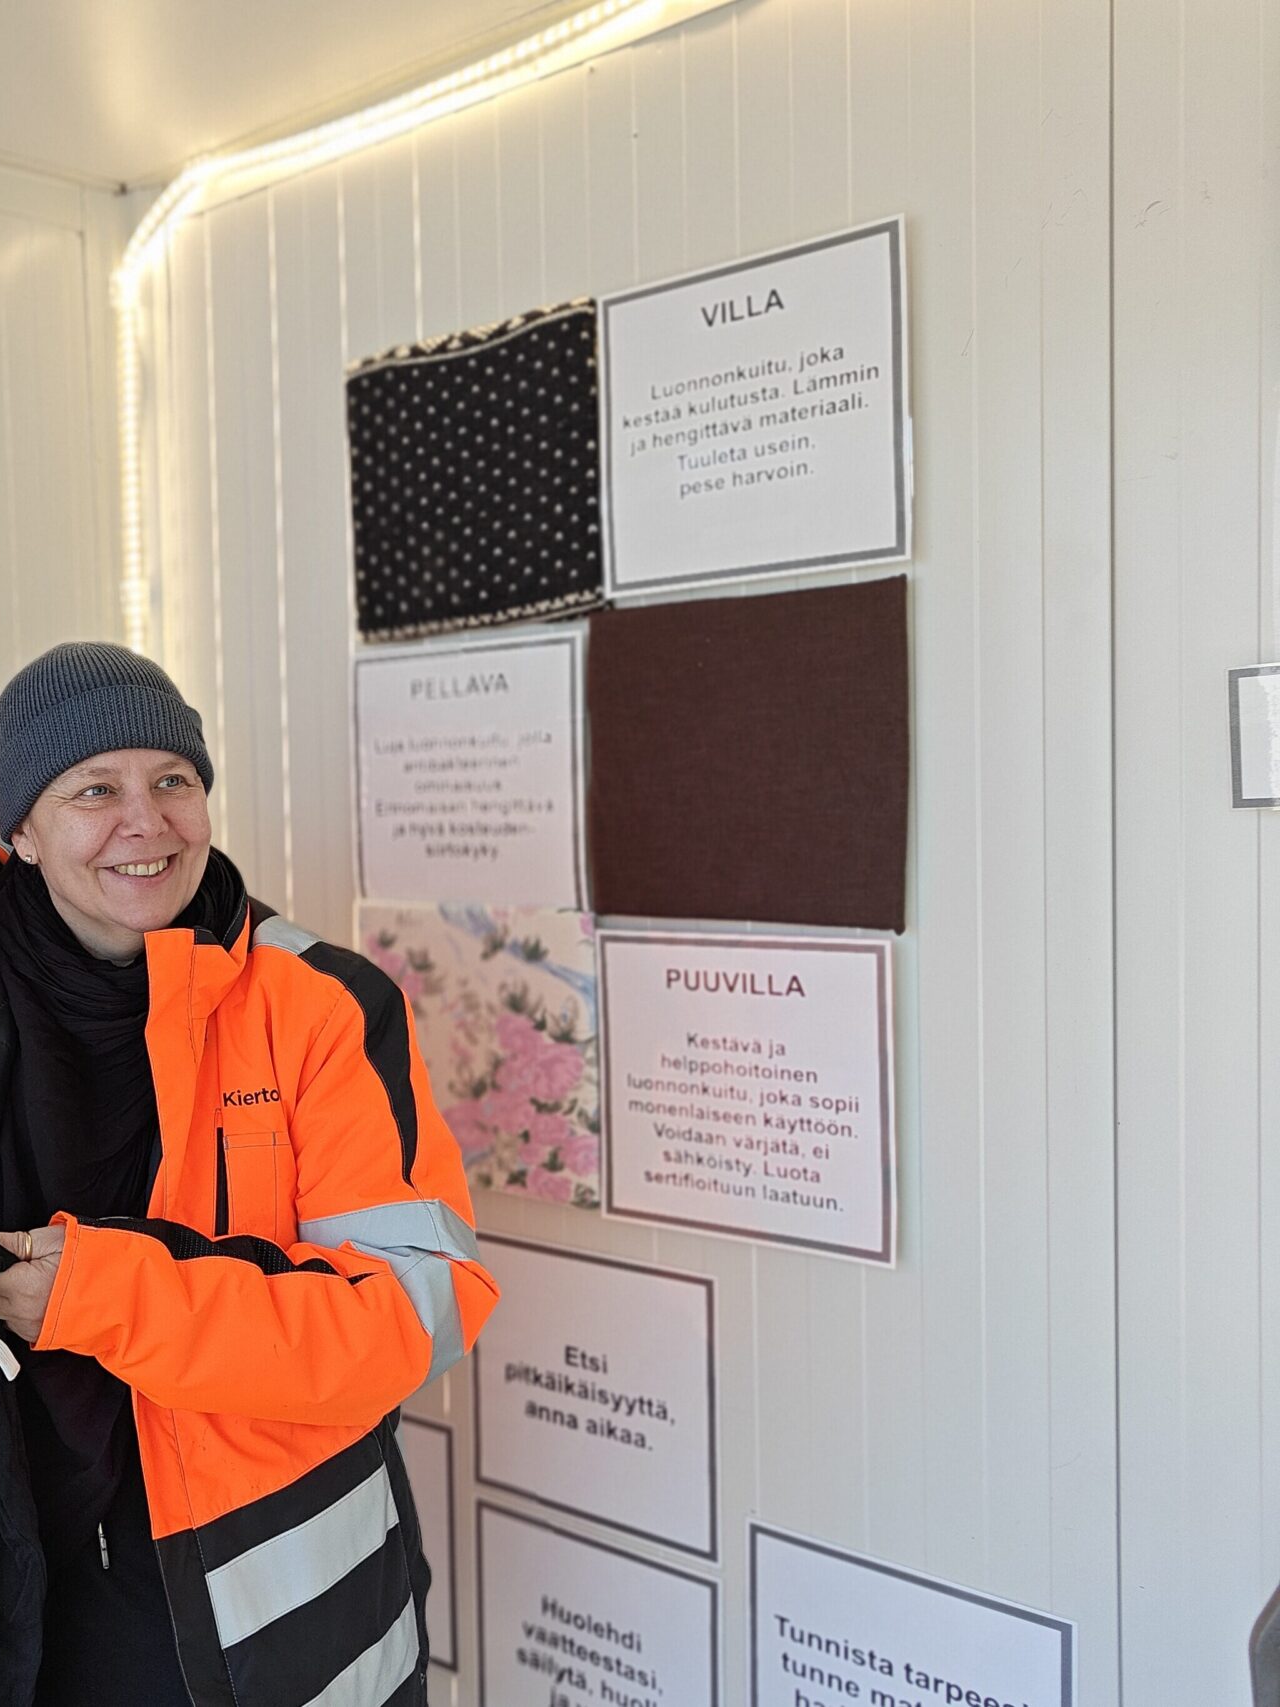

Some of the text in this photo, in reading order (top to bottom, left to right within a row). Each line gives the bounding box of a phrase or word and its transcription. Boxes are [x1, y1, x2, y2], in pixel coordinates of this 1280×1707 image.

[702, 289, 784, 327] VILLA
[651, 345, 844, 400] Luonnonkuitu, joka
[623, 365, 880, 429] kestää kulutusta. Lämmin
[630, 392, 869, 456] ja hengittävä materiaali.
[678, 446, 747, 472] Tuuleta
[680, 460, 814, 499] pese harvoin.
[410, 672, 509, 700] PELLAVA
[666, 968, 805, 997] PUUVILLA
[687, 1032, 786, 1059] Kestävä ja
[661, 1054, 817, 1084] helppohoitoinen
[222, 1087, 280, 1107] Kierto
[627, 1074, 860, 1115] luonnonkuitu, joka sopii
[629, 1099, 858, 1139] monenlaiseen käyttöön.
[654, 1123, 726, 1146] Voidaan
[813, 1143, 830, 1160] ei
[644, 1169, 844, 1212] sertifioituun laatuun.
[763, 1161, 821, 1184] Luota
[565, 1345, 607, 1374] Etsi
[504, 1362, 675, 1425] pitkäikäisyyttä,
[525, 1400, 653, 1450] anna aikaa.
[541, 1595, 642, 1654] Huolehdi
[522, 1621, 663, 1697] vaatteestasi,
[774, 1613, 894, 1677] Tunnista
[781, 1652, 860, 1699] tunne
